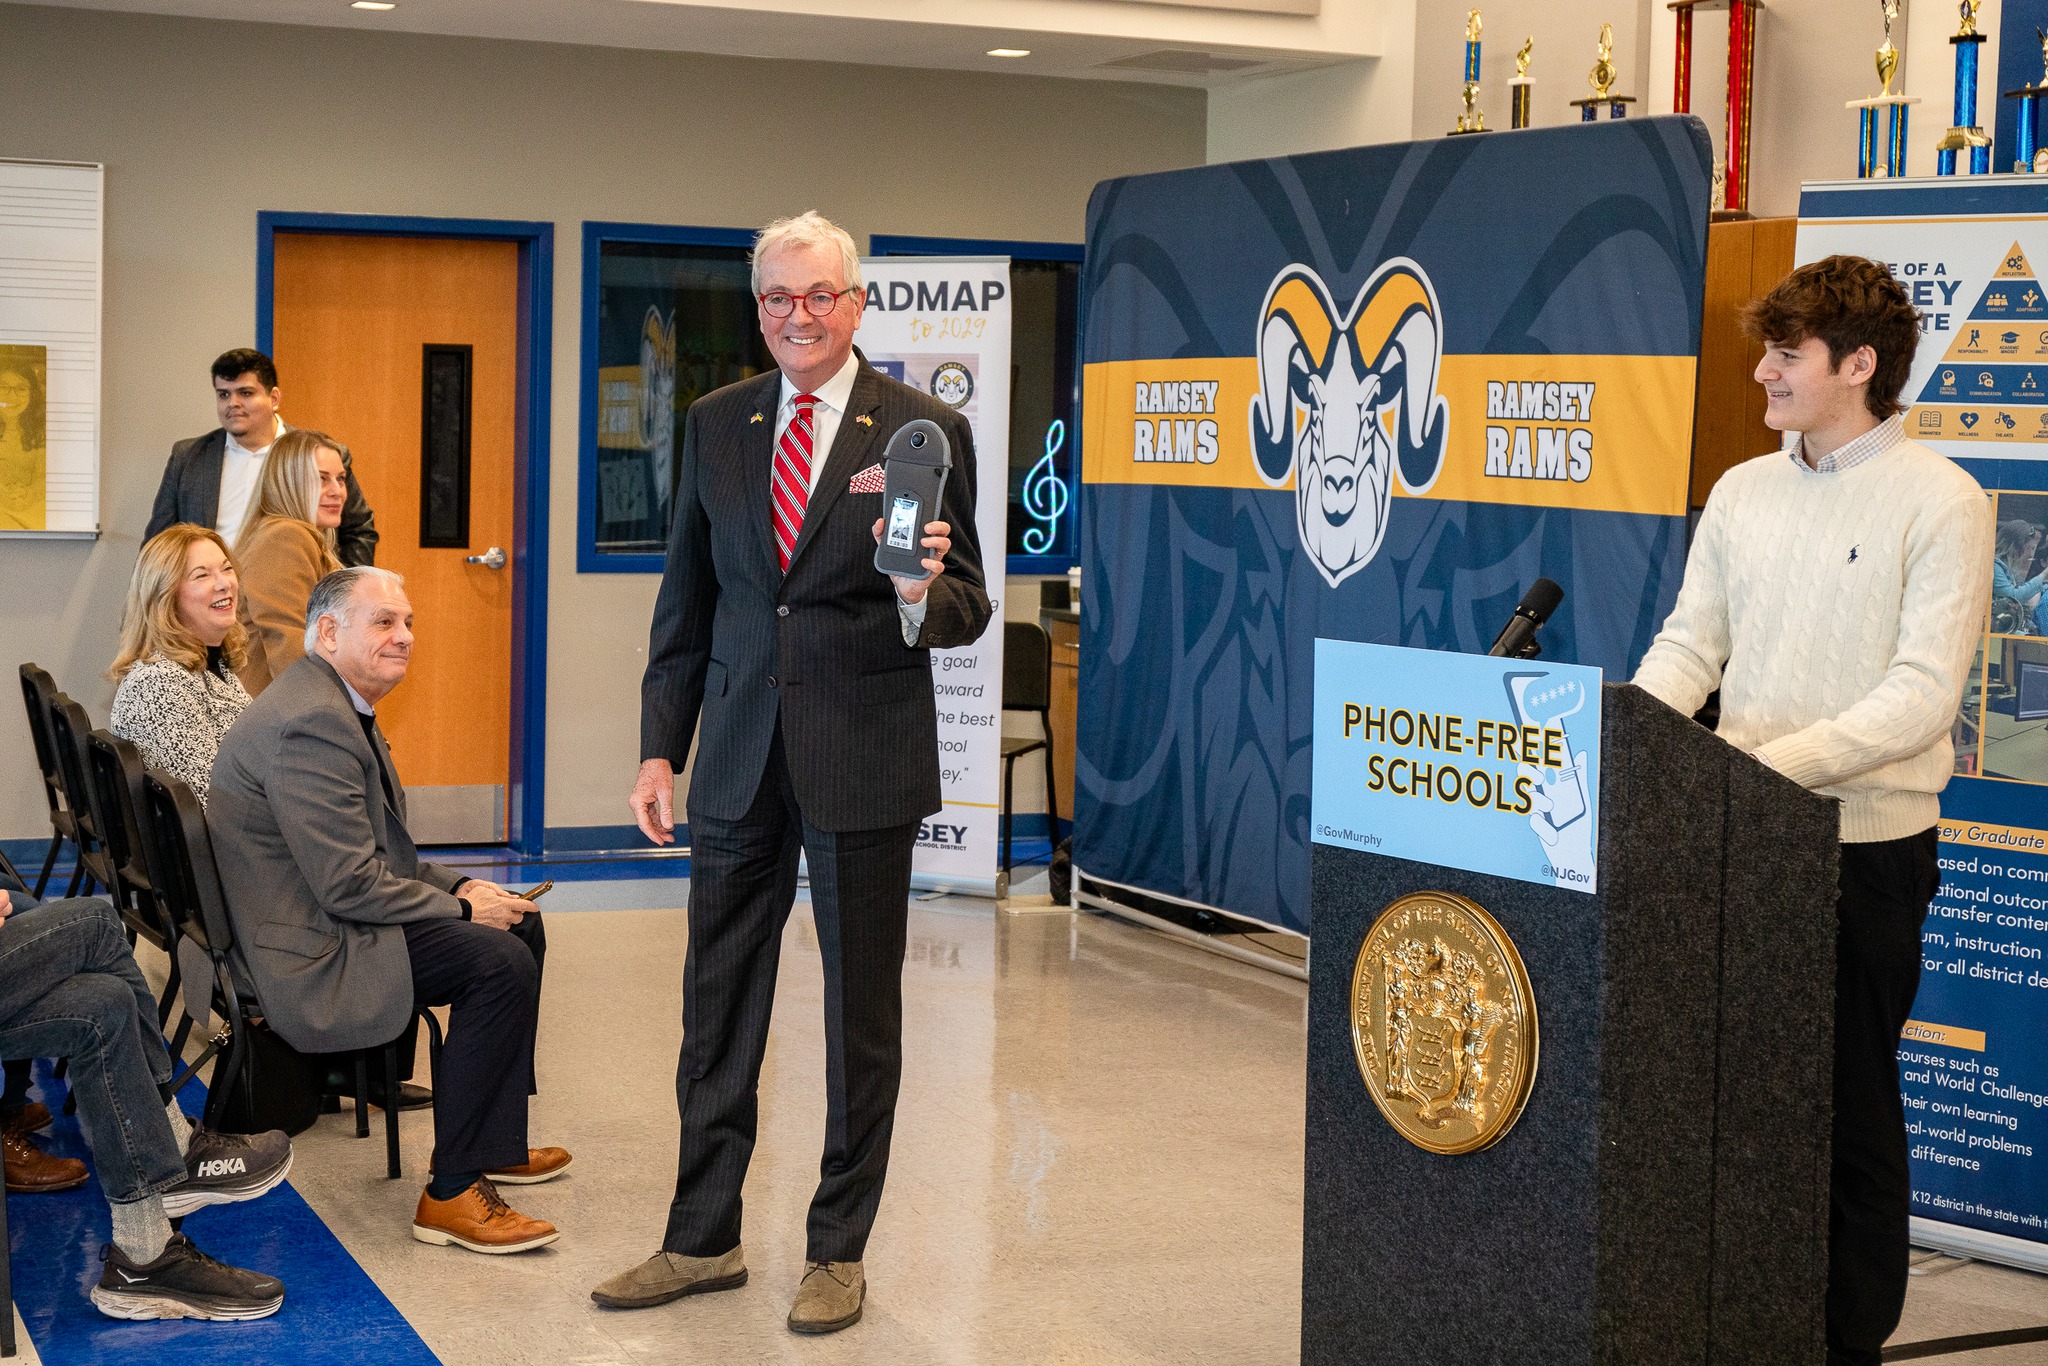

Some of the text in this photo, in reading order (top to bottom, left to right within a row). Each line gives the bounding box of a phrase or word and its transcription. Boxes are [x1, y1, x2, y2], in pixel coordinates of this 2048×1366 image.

[1904, 262, 1928, 276] OF
[1934, 262, 1946, 276] A
[862, 280, 1005, 312] ADMAP
[910, 317, 987, 342] to 2029
[1134, 380, 1219, 414] RAMSEY
[1486, 380, 1596, 422] RAMSEY
[1133, 419, 1219, 464] RAMS
[1484, 426, 1594, 484] RAMS
[942, 656, 978, 672] goal
[934, 684, 984, 698] oward
[936, 710, 996, 726] he best
[1343, 702, 1563, 768] PHONE-FREE
[942, 767, 969, 784] ey."
[1366, 754, 1534, 816] SCHOOLS
[917, 822, 968, 844] SEY
[1316, 824, 1382, 848] @GovMurphy
[1937, 826, 2045, 850] sey Graduate
[940, 844, 966, 852] DISTRICT
[1541, 864, 1590, 885] @NJGov
[1937, 857, 1978, 874] ased
[1982, 864, 2002, 876] on
[1936, 883, 1990, 902] ational
[1928, 901, 1993, 923] transfer
[1412, 905, 1442, 924] THE
[1446, 910, 1487, 953] STATE
[1955, 932, 2042, 960] instruction
[1946, 958, 1966, 976] all
[1970, 962, 2024, 984] district
[1896, 1050, 1999, 1078] courses such as
[1904, 1070, 1930, 1084] and
[1934, 1072, 1974, 1092] World
[1932, 1102, 1960, 1116] own
[1964, 1104, 2018, 1130] learning
[1904, 1120, 2032, 1156] eal-world problems
[198, 1158, 246, 1178] HOKA
[1911, 1145, 1980, 1171] difference
[1912, 1190, 1931, 1204] K12
[1933, 1195, 1964, 1211] district
[1966, 1202, 1974, 1213] in
[1976, 1204, 1992, 1217] the
[1994, 1208, 2018, 1222] state
[2020, 1214, 2042, 1228] with
